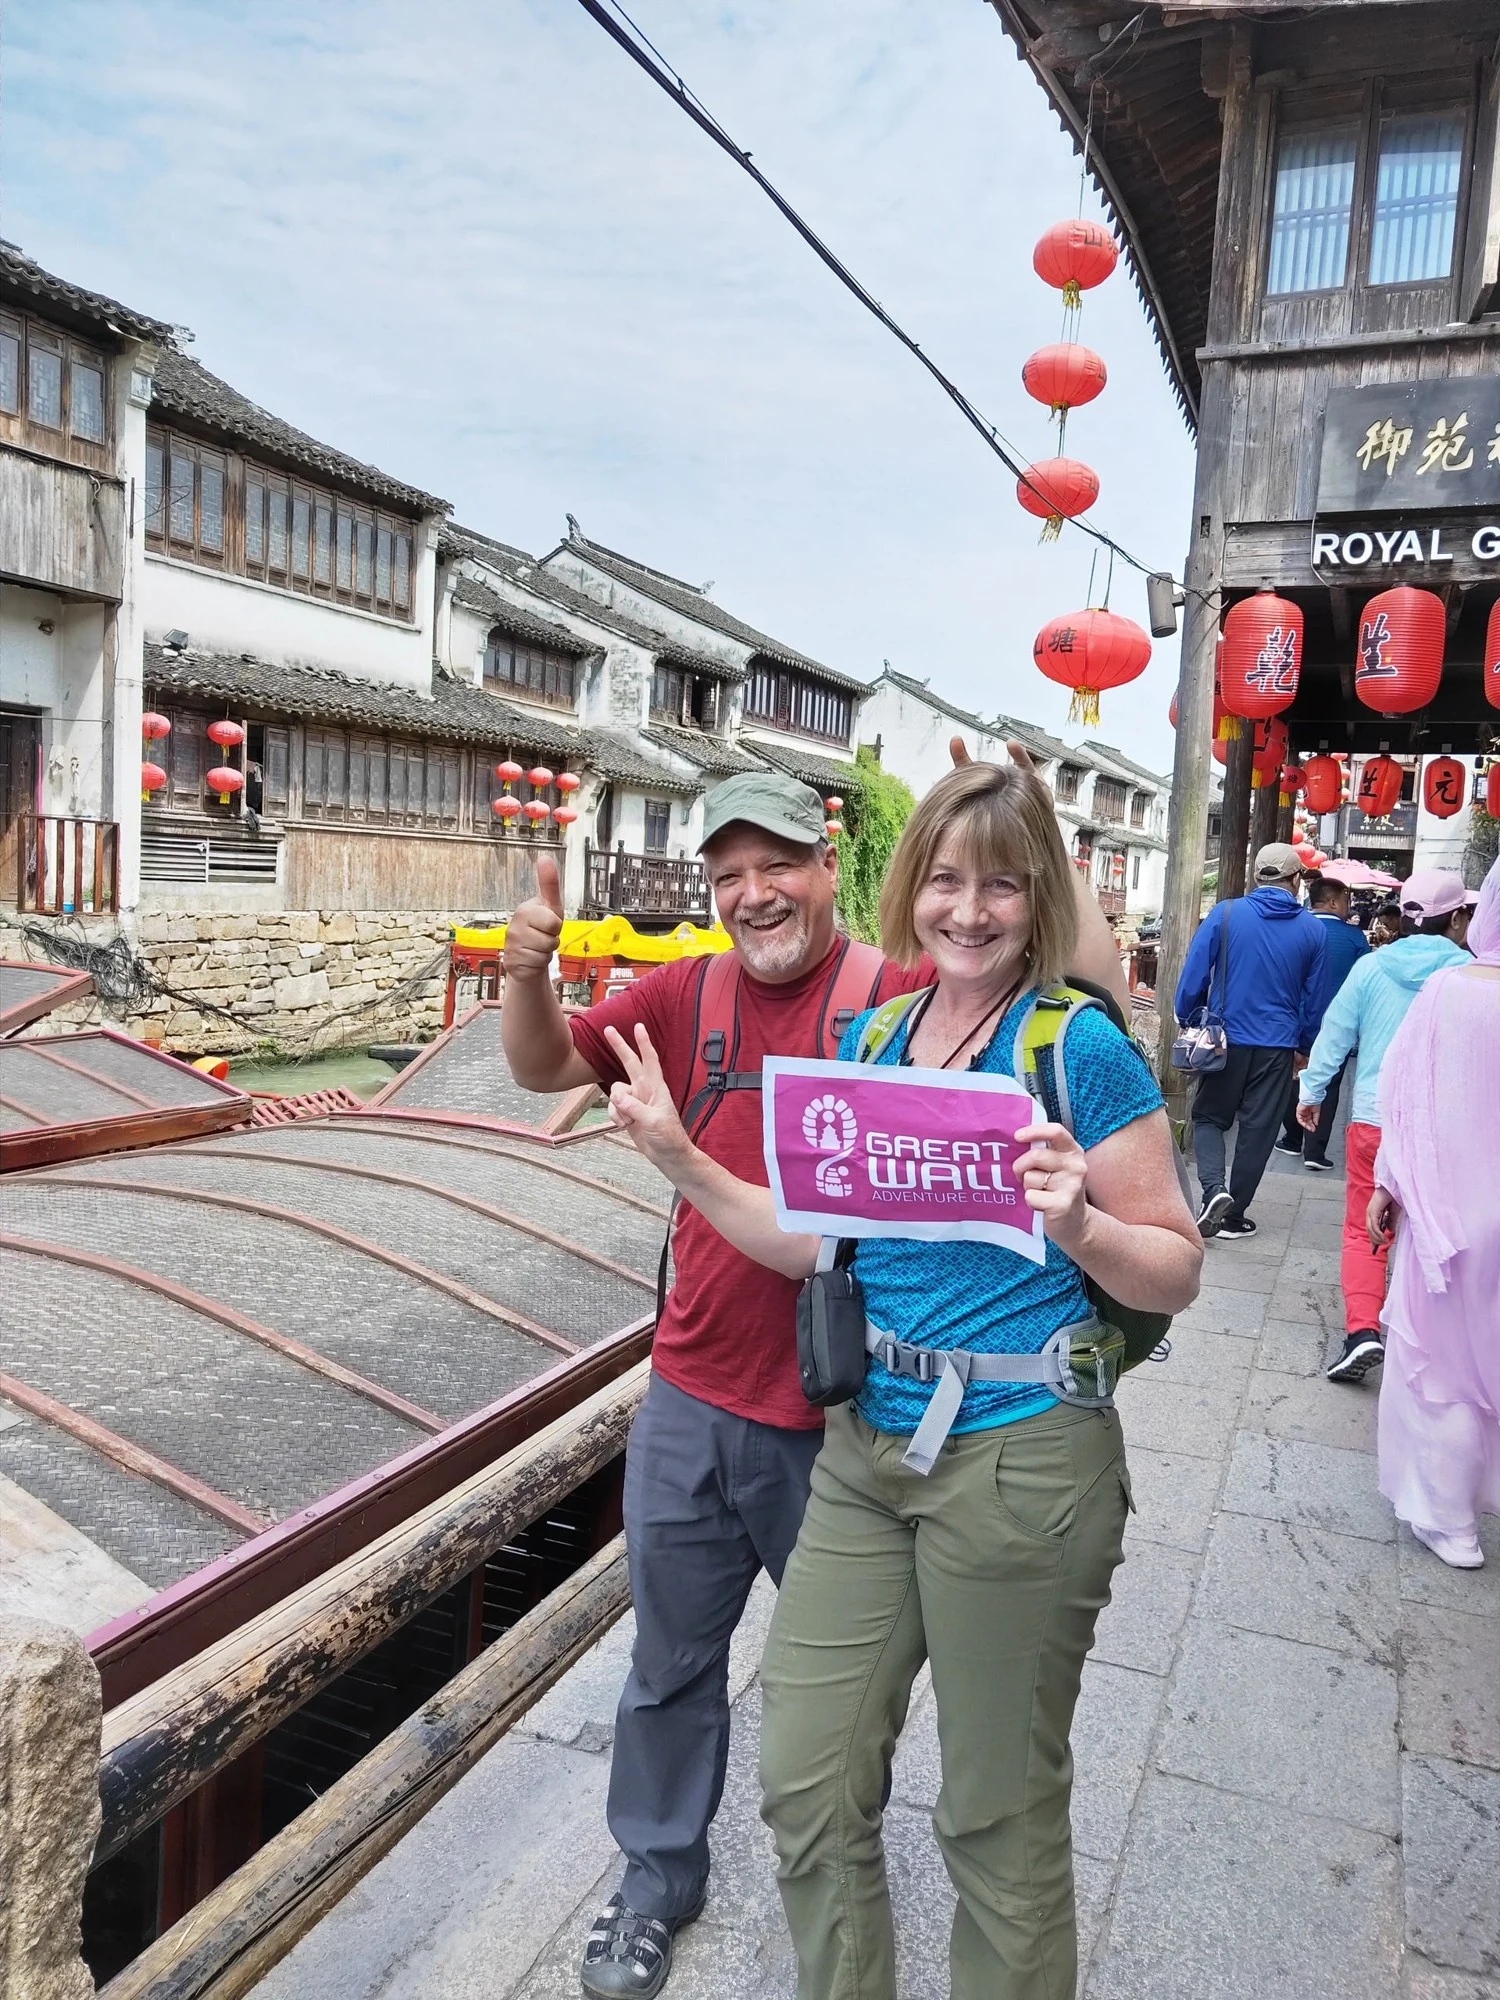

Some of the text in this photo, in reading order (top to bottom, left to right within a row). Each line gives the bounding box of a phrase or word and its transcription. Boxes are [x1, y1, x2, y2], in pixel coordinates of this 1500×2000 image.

[1312, 529, 1454, 565] ROYAL
[1356, 613, 1399, 683] 生
[1359, 767, 1378, 798] 生
[1429, 771, 1458, 805] 元
[866, 1131, 1008, 1161] GREAT
[868, 1155, 1015, 1191] WALL
[871, 1189, 1016, 1206] ADVENTURE CLUB
